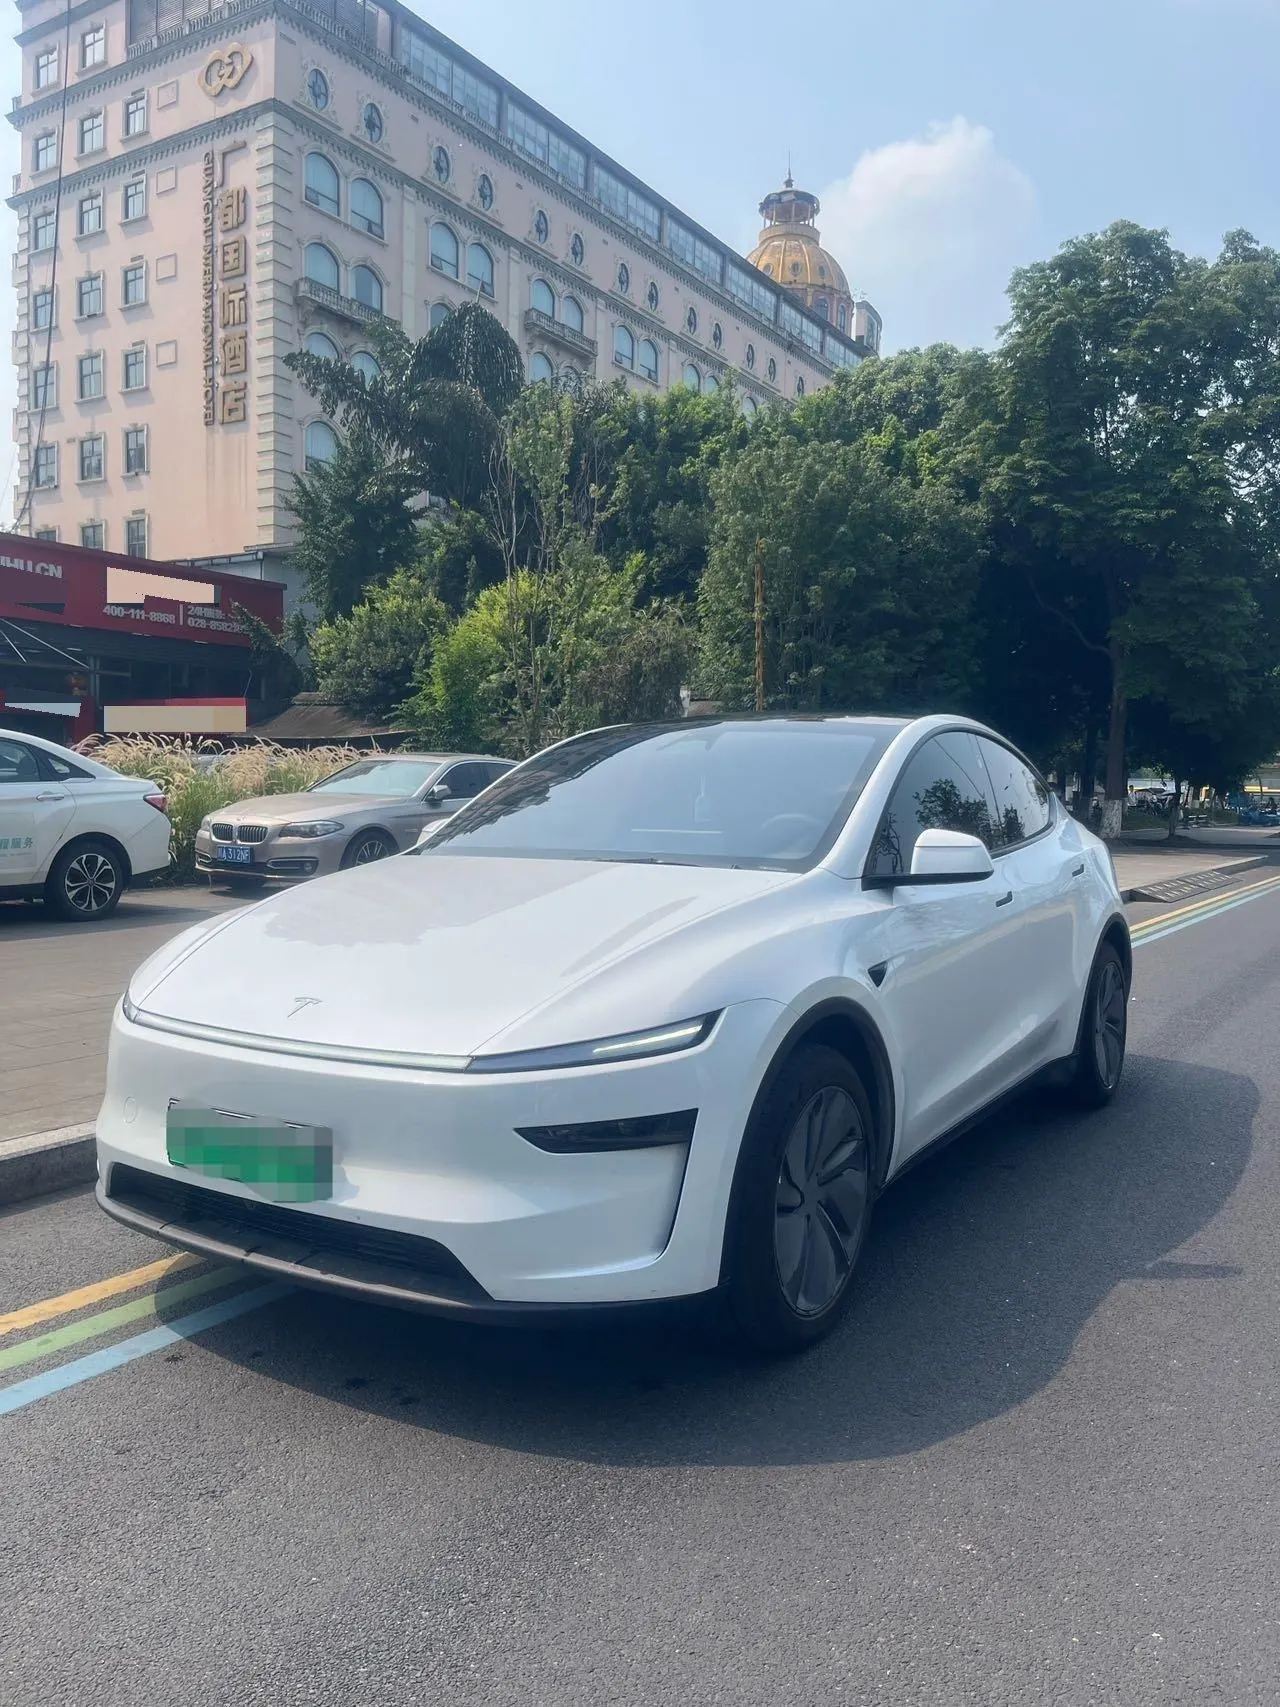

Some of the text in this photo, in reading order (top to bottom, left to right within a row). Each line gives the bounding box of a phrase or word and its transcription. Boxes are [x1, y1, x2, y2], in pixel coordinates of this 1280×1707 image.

[214, 140, 247, 425] 广都国际酒店
[203, 377, 214, 426] HOTEL
